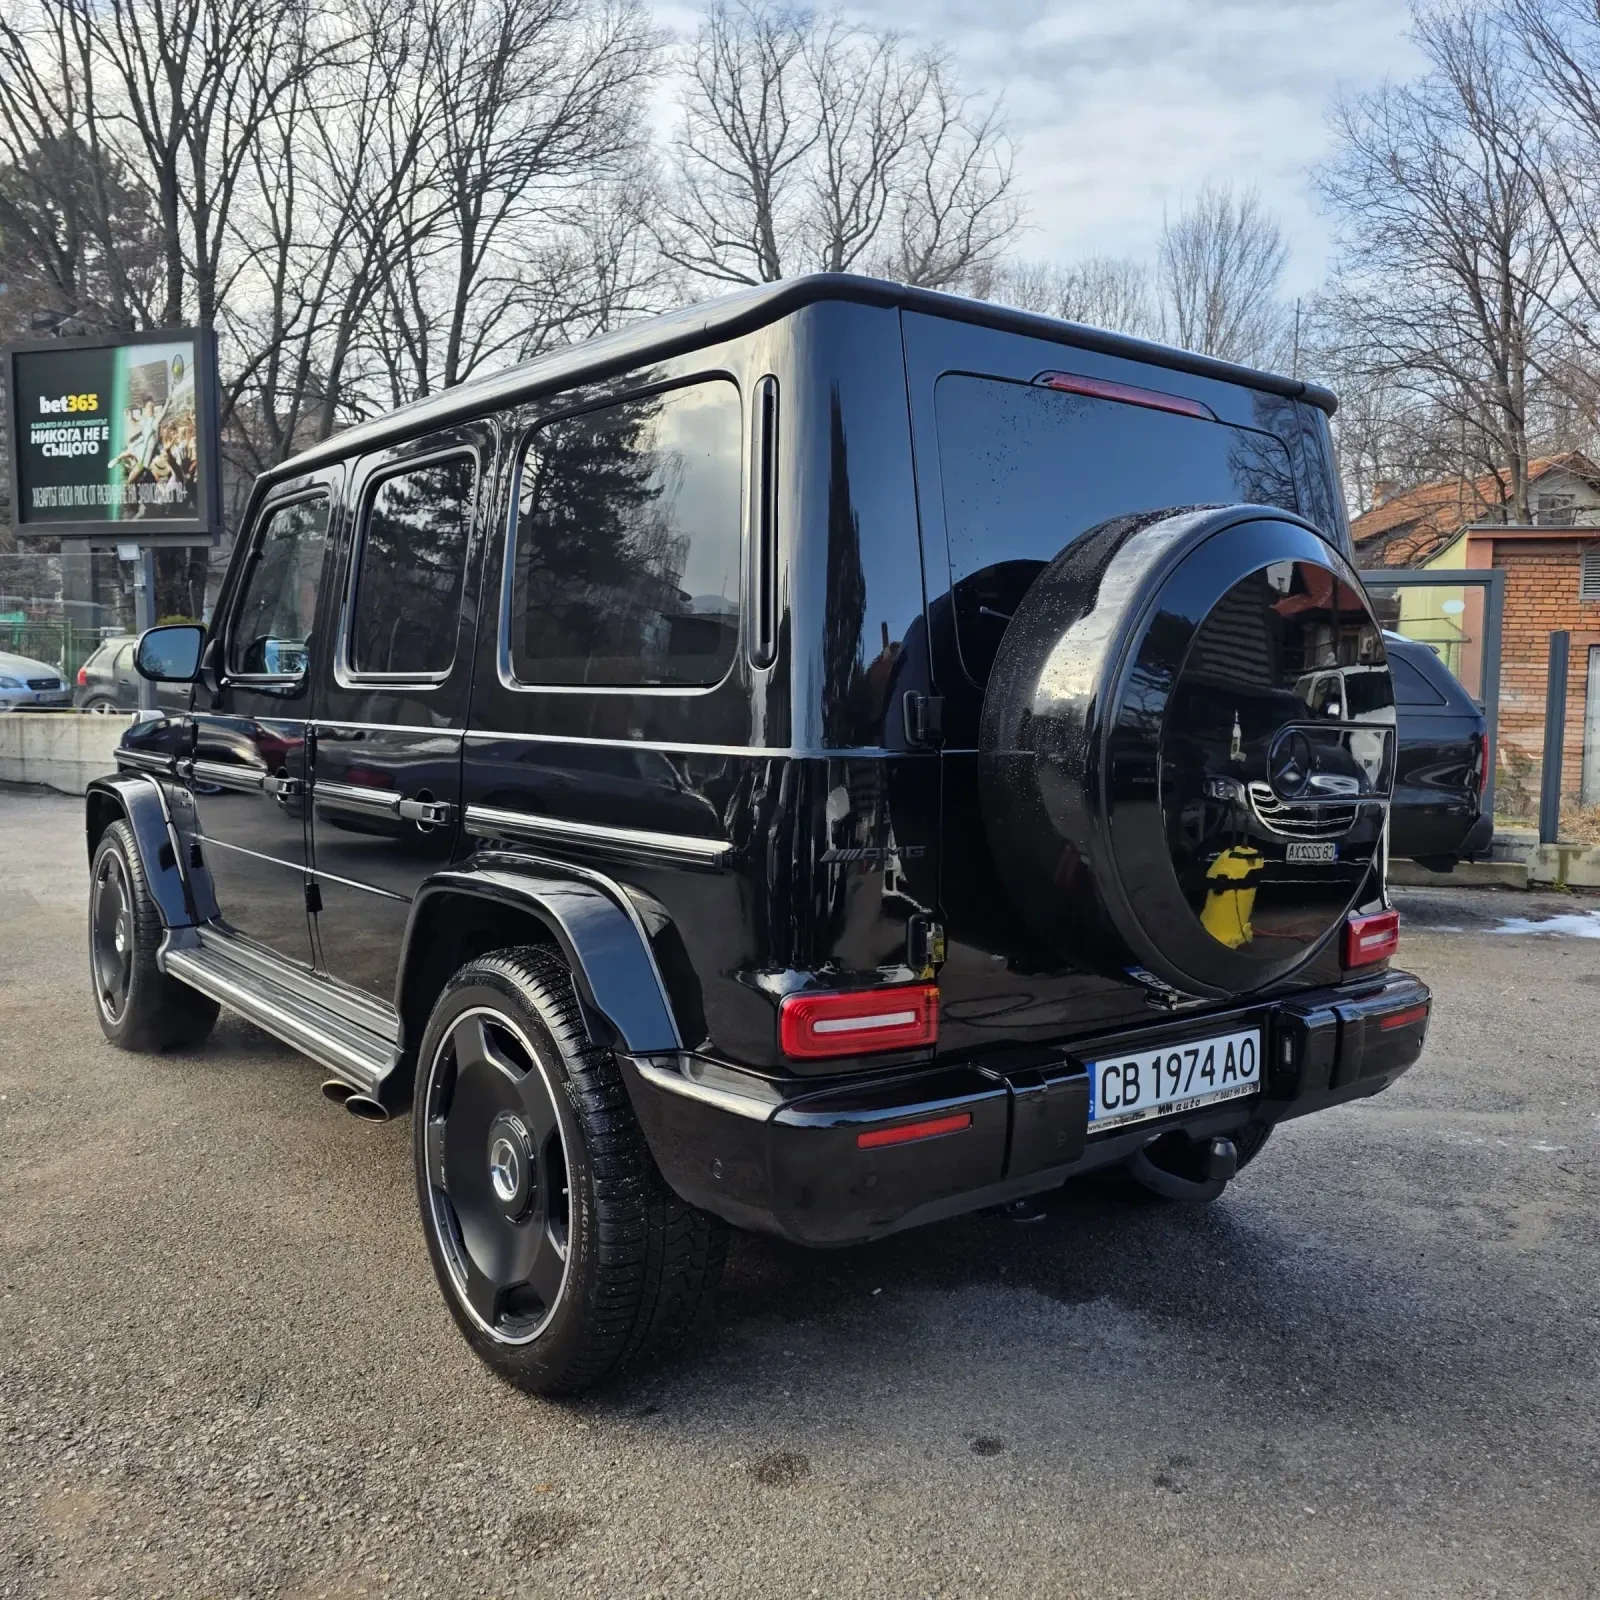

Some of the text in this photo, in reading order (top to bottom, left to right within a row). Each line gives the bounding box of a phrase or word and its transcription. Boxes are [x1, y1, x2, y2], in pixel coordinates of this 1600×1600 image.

[39, 393, 99, 414] bet365
[30, 425, 110, 445] НИКОГА НЕ Е
[41, 440, 100, 459] СЪЩОТО
[74, 485, 89, 506] РИСК
[89, 485, 97, 506] ОТ
[1101, 1037, 1255, 1110] CB 1974 AO
[1157, 1103, 1173, 1116] MM
[1176, 1099, 1201, 1112] auto
